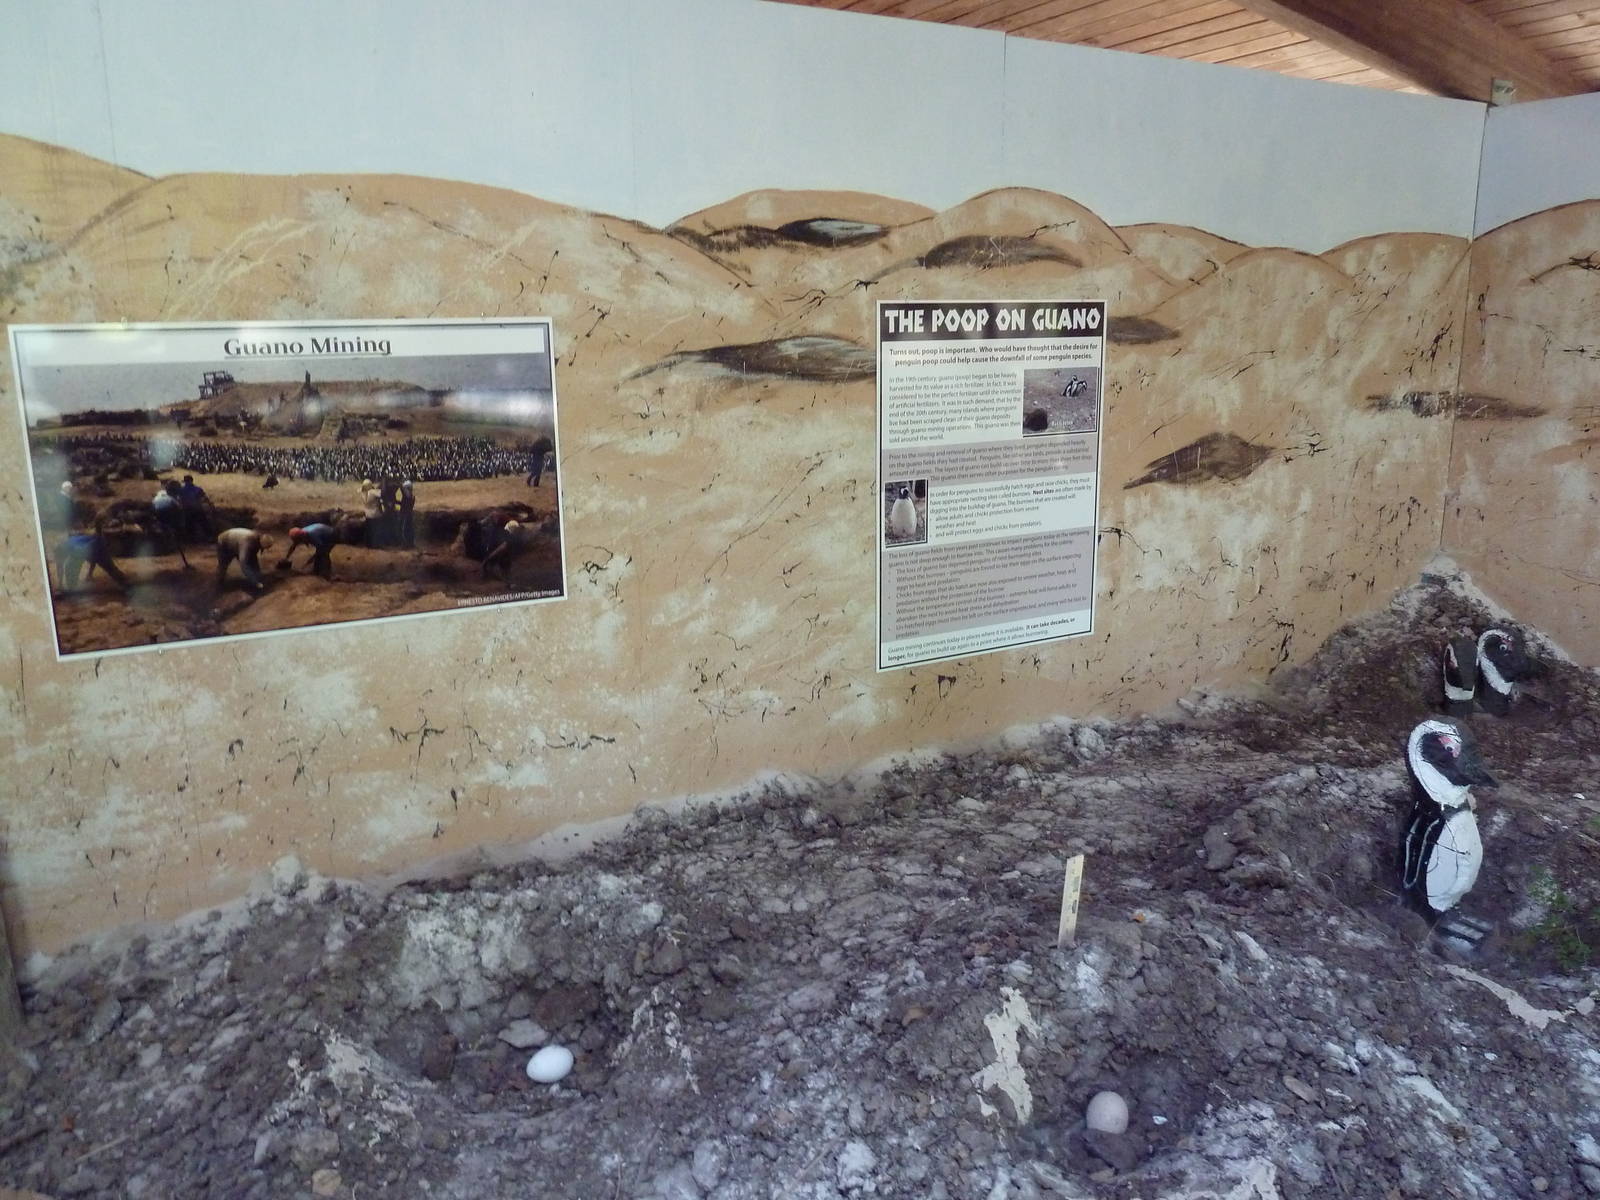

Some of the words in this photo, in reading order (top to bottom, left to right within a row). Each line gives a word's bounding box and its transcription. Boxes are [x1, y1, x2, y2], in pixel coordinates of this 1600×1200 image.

[885, 309, 924, 333] THE
[932, 308, 989, 332] POOP
[996, 309, 1025, 331] ON
[1032, 307, 1101, 331] GUANO
[224, 338, 304, 356] Guano
[311, 336, 392, 355] Mining
[1026, 344, 1049, 352] thought
[894, 358, 921, 367] penguin
[957, 356, 970, 364] help
[999, 354, 1025, 362] downfall
[1048, 353, 1071, 361] penguin
